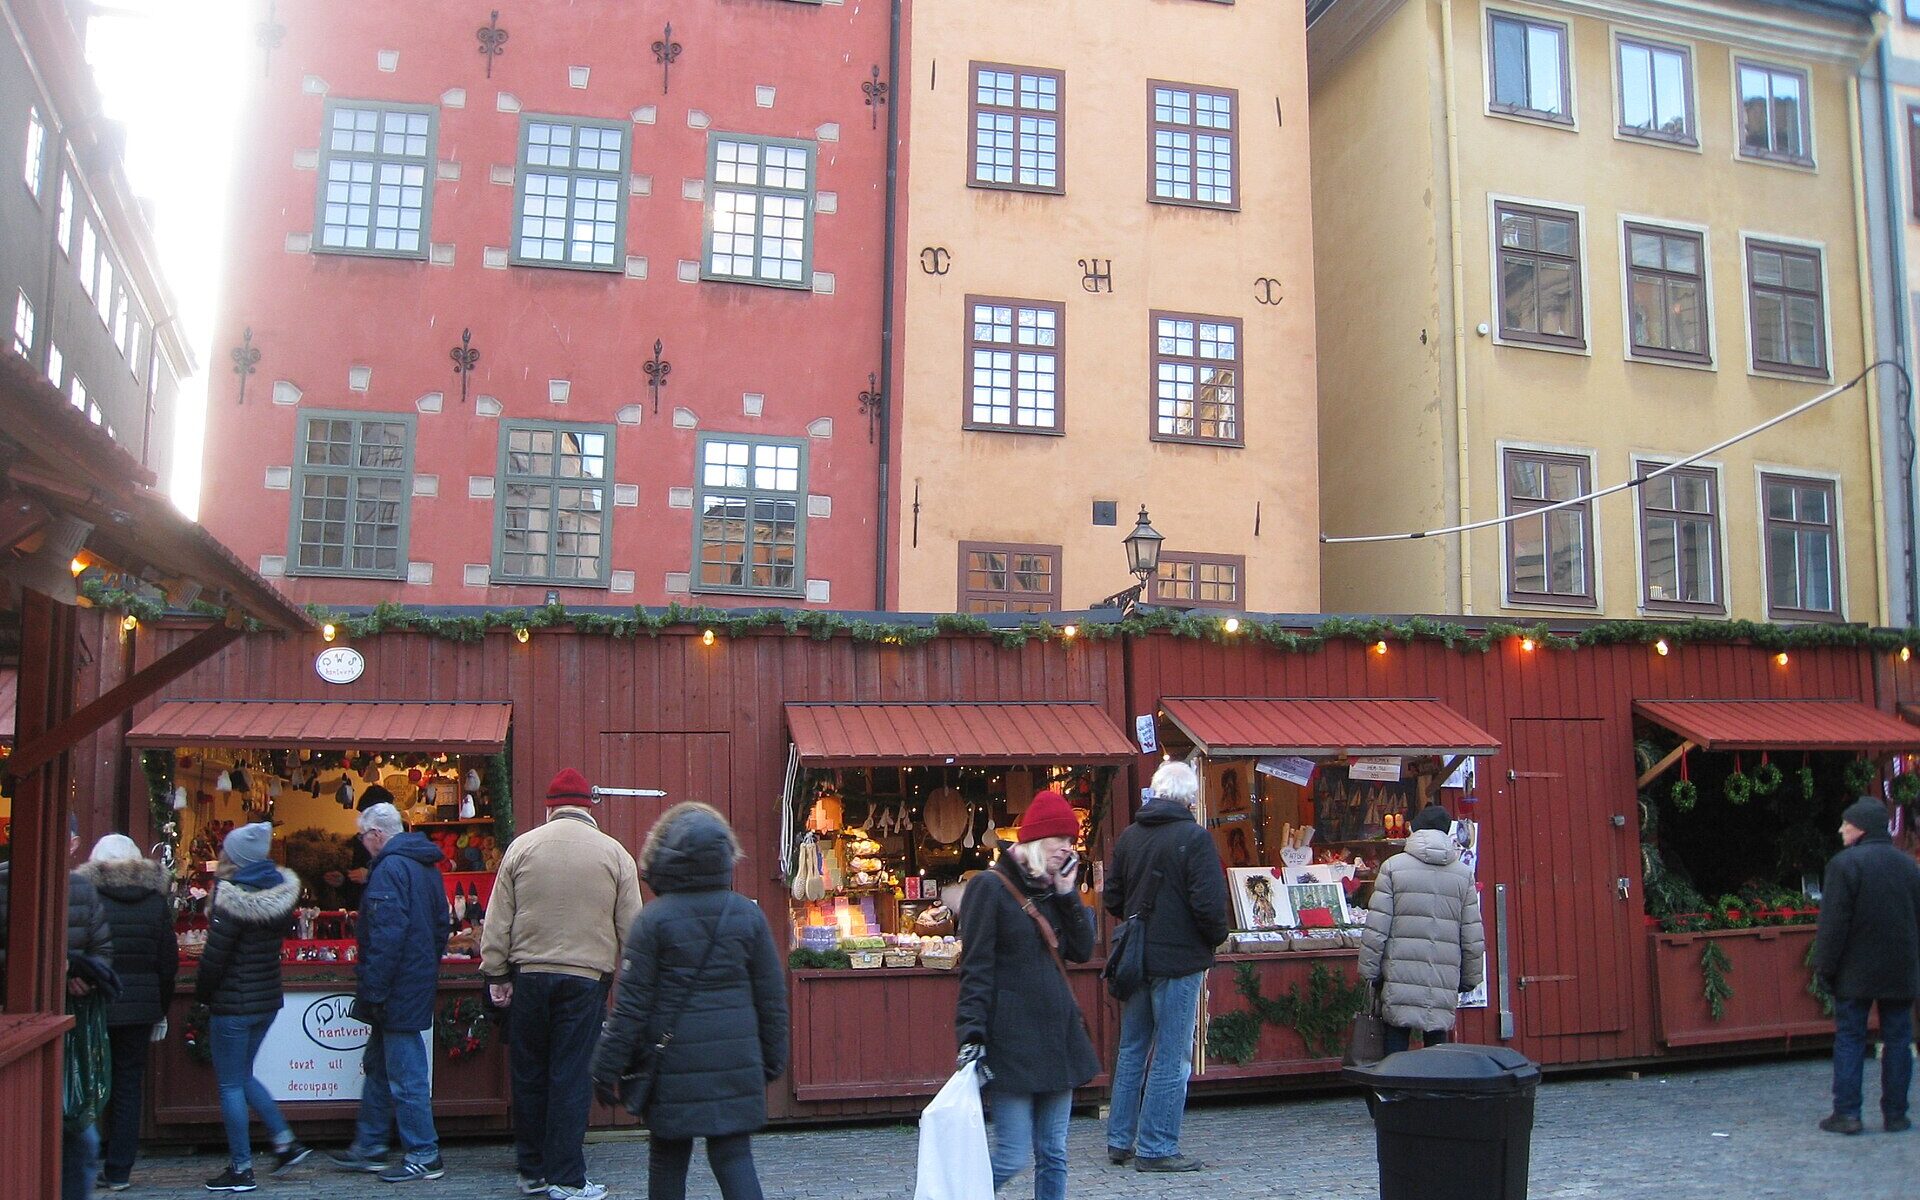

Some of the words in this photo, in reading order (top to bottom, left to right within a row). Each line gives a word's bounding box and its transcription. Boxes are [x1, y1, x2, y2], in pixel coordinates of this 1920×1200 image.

[318, 1025, 371, 1038] hantverk
[289, 1059, 315, 1070] tovat
[328, 1058, 343, 1070] ull
[288, 1080, 339, 1097] decoupage
